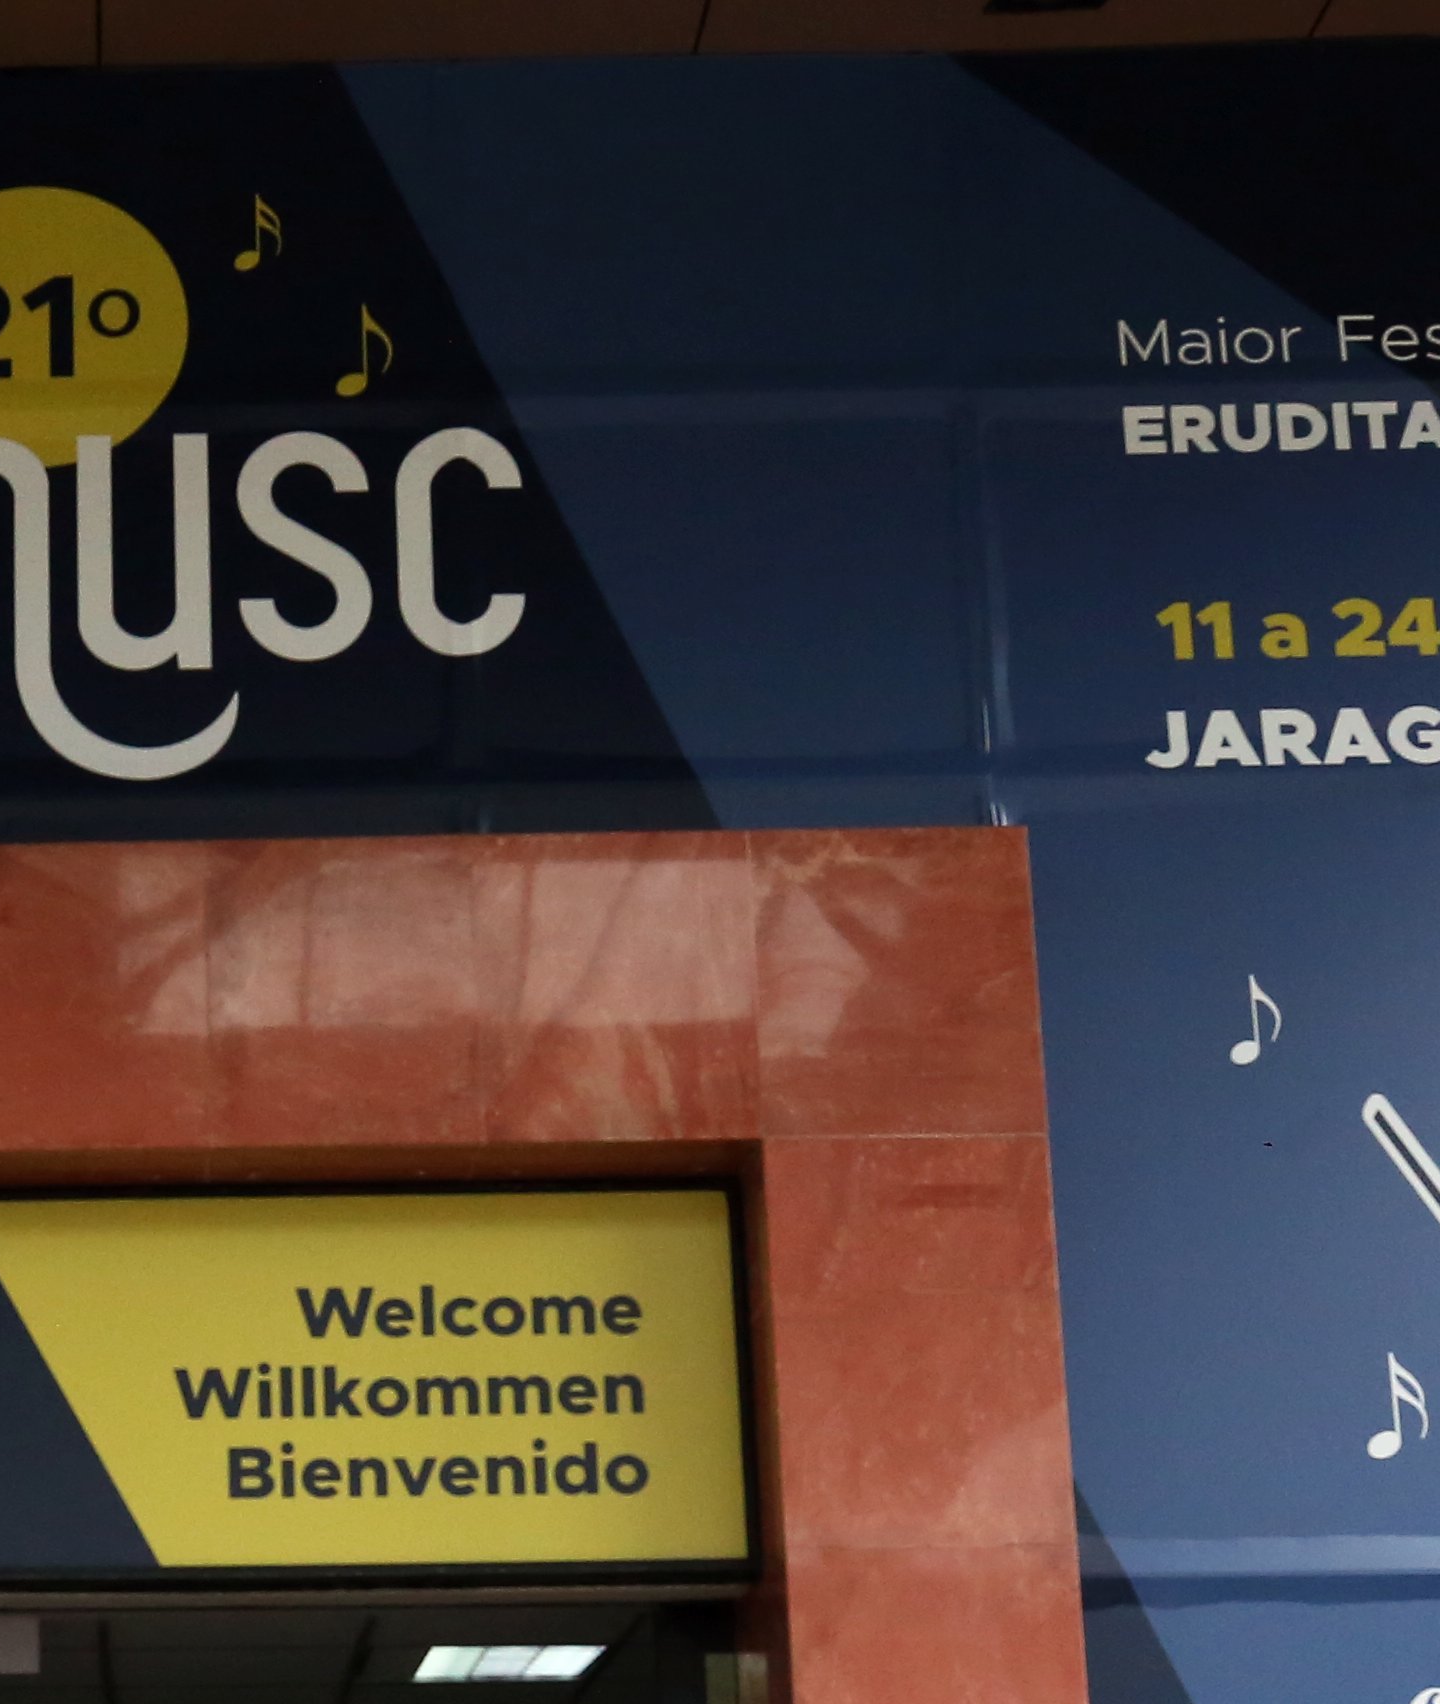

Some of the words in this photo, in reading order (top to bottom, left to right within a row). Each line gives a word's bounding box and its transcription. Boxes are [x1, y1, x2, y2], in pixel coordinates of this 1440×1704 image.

[1118, 319, 1304, 366] Maior
[1156, 605, 1233, 660] 11
[1260, 612, 1309, 658] a
[297, 1285, 643, 1338] Welcome
[174, 1362, 645, 1420] Willkommen
[227, 1441, 650, 1500] Bienvenido
